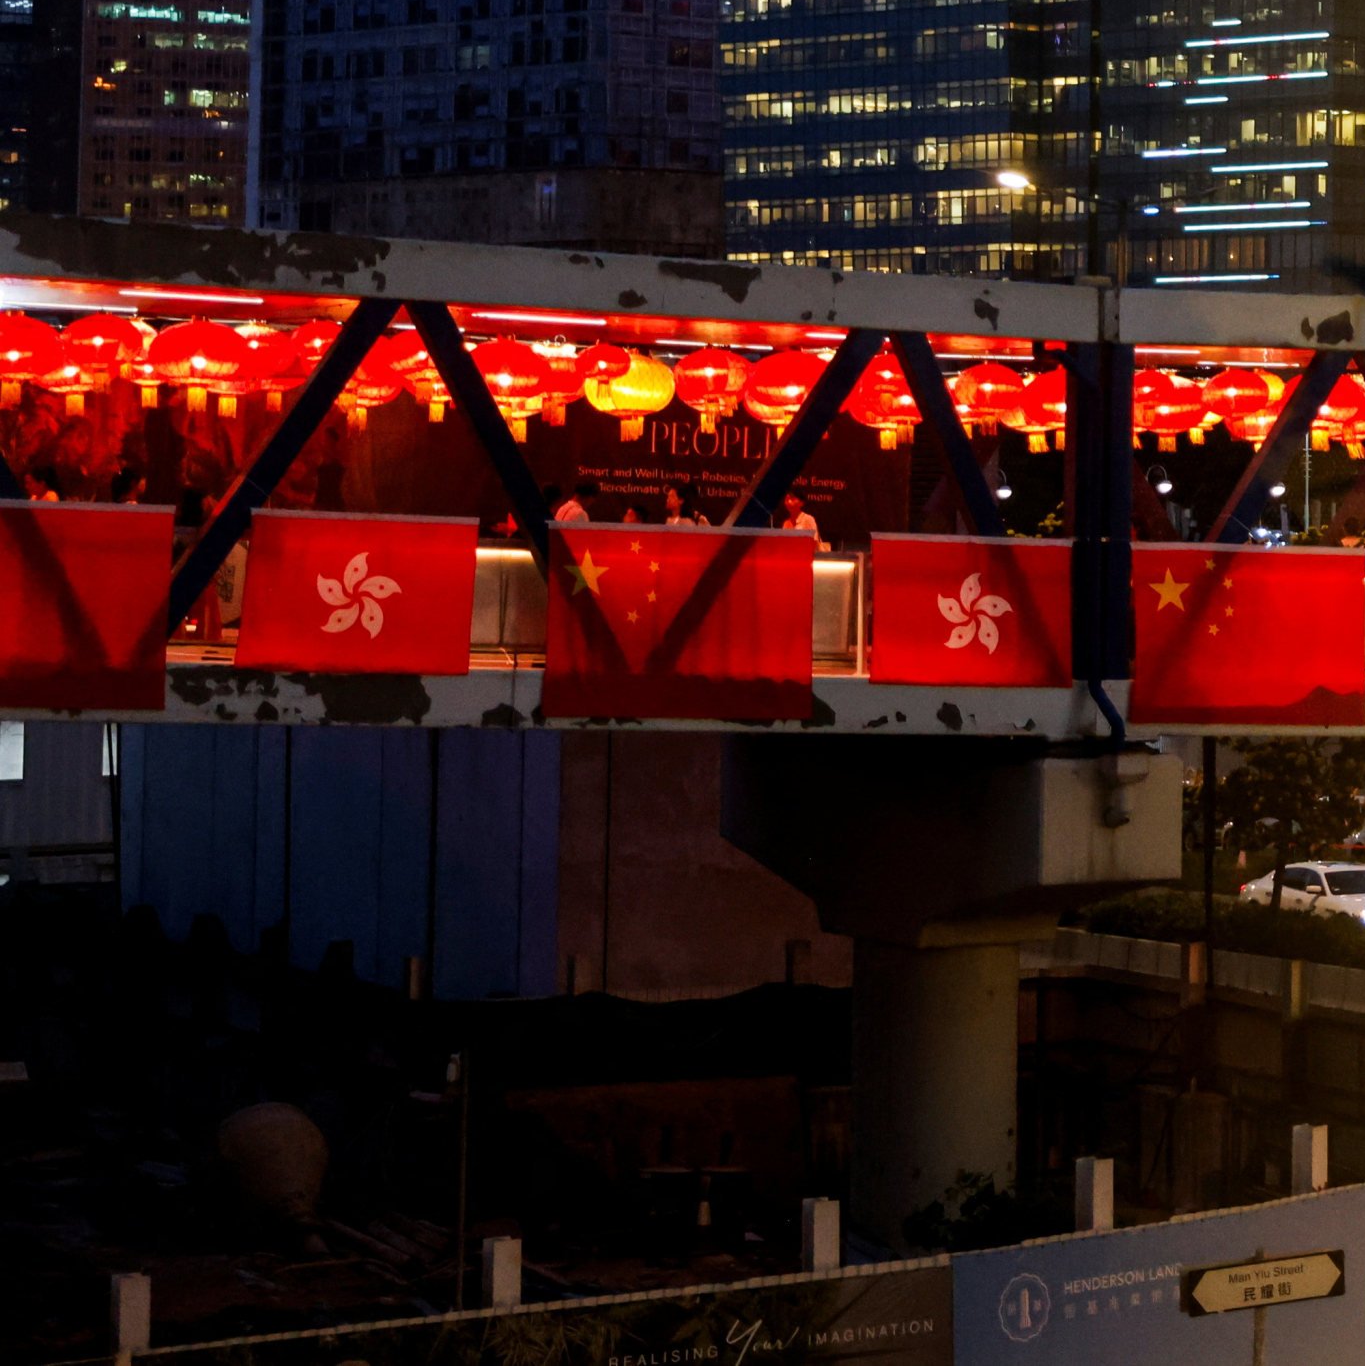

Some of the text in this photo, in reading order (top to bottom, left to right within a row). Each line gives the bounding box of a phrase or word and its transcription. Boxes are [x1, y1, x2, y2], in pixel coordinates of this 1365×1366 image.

[577, 465, 609, 477] Smart
[613, 467, 632, 478] and
[661, 469, 690, 483] Living
[1063, 1268, 1145, 1295] HENDERSON
[1228, 1263, 1304, 1284] Man Yiu Street
[1243, 1281, 1292, 1302] 民耀街
[608, 1345, 720, 1366] REALISING
[807, 1318, 935, 1347] IMAGINATION
